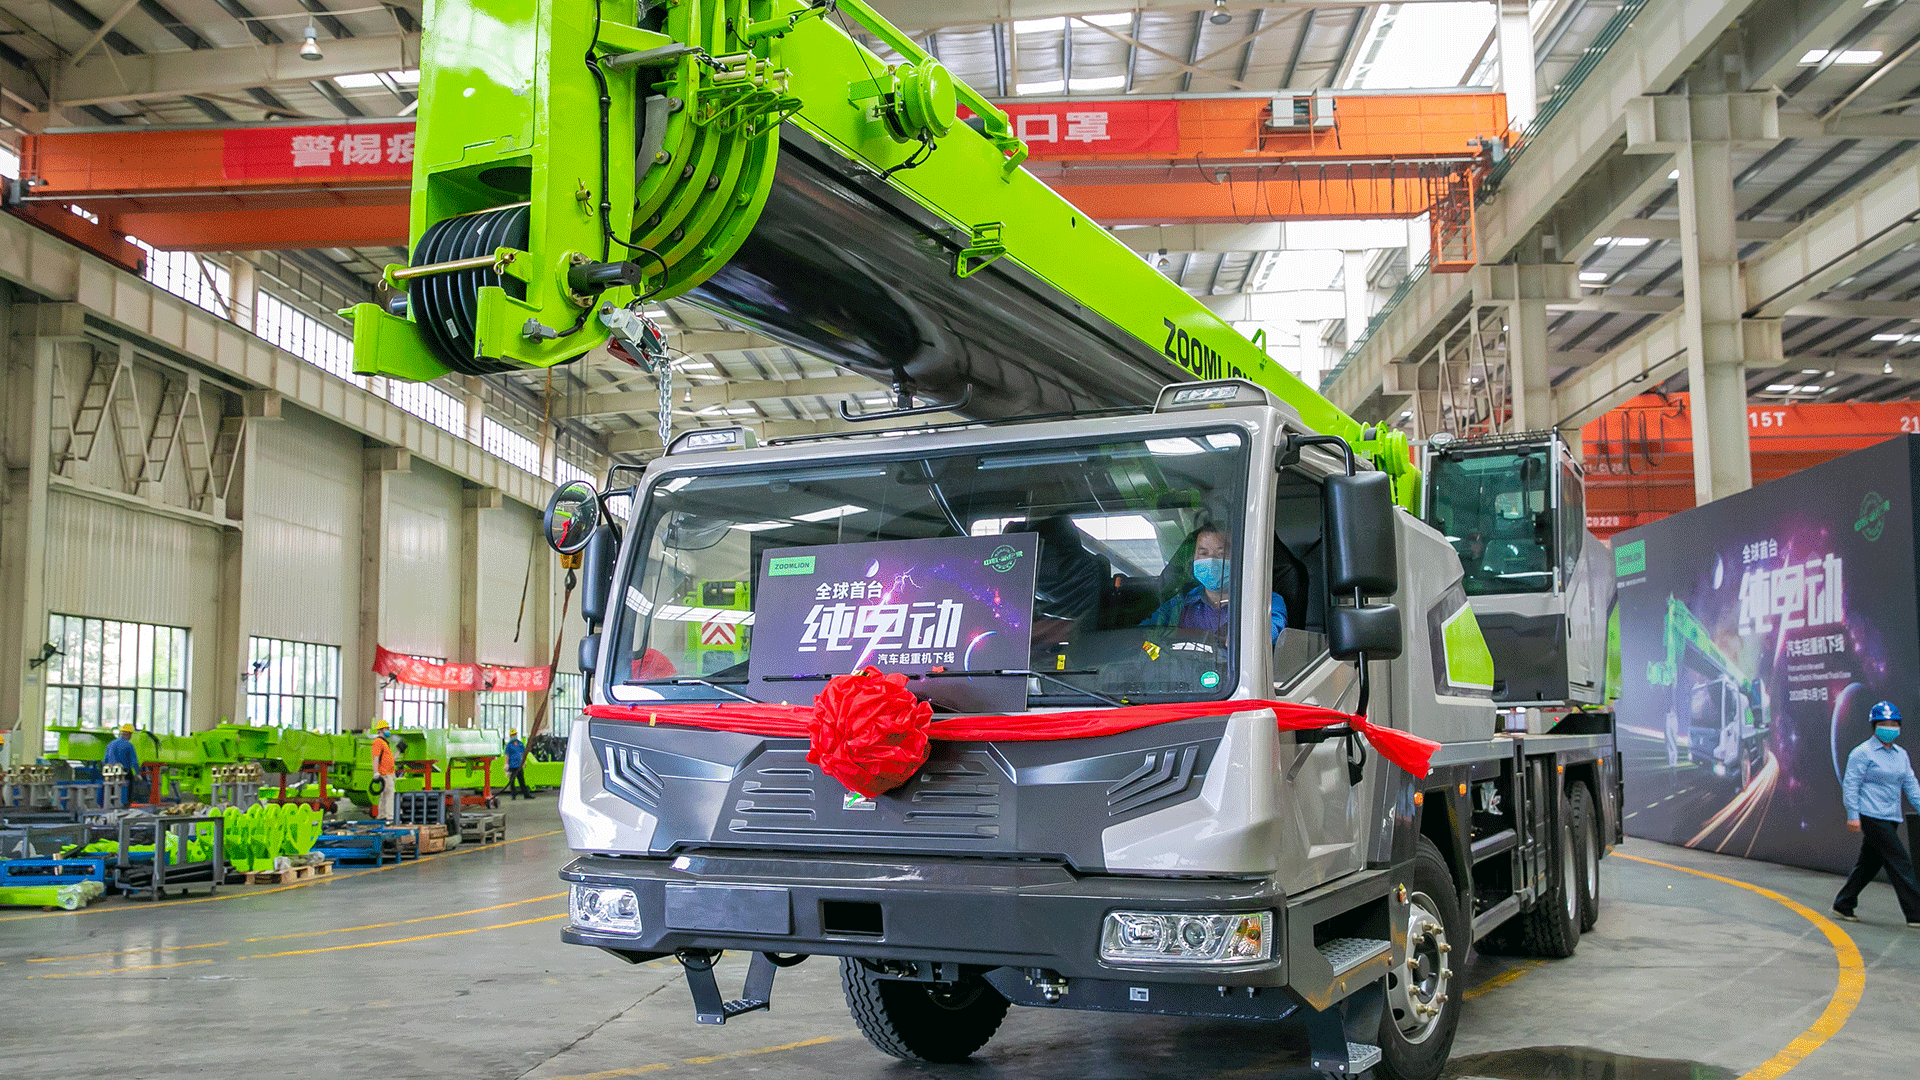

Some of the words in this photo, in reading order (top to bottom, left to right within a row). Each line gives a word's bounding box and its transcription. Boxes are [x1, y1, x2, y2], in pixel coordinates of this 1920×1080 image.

[1017, 112, 1111, 143] 口罩
[1163, 316, 1253, 381] ZOOML
[1749, 411, 1786, 427] 15T
[1742, 538, 1778, 564] 全球首台
[774, 562, 810, 570] ZOOMLION
[815, 580, 884, 601] 全球首台
[1738, 553, 1842, 637] 纯电动
[798, 598, 964, 654] 纯电动
[877, 652, 955, 665] 汽车起重机下线
